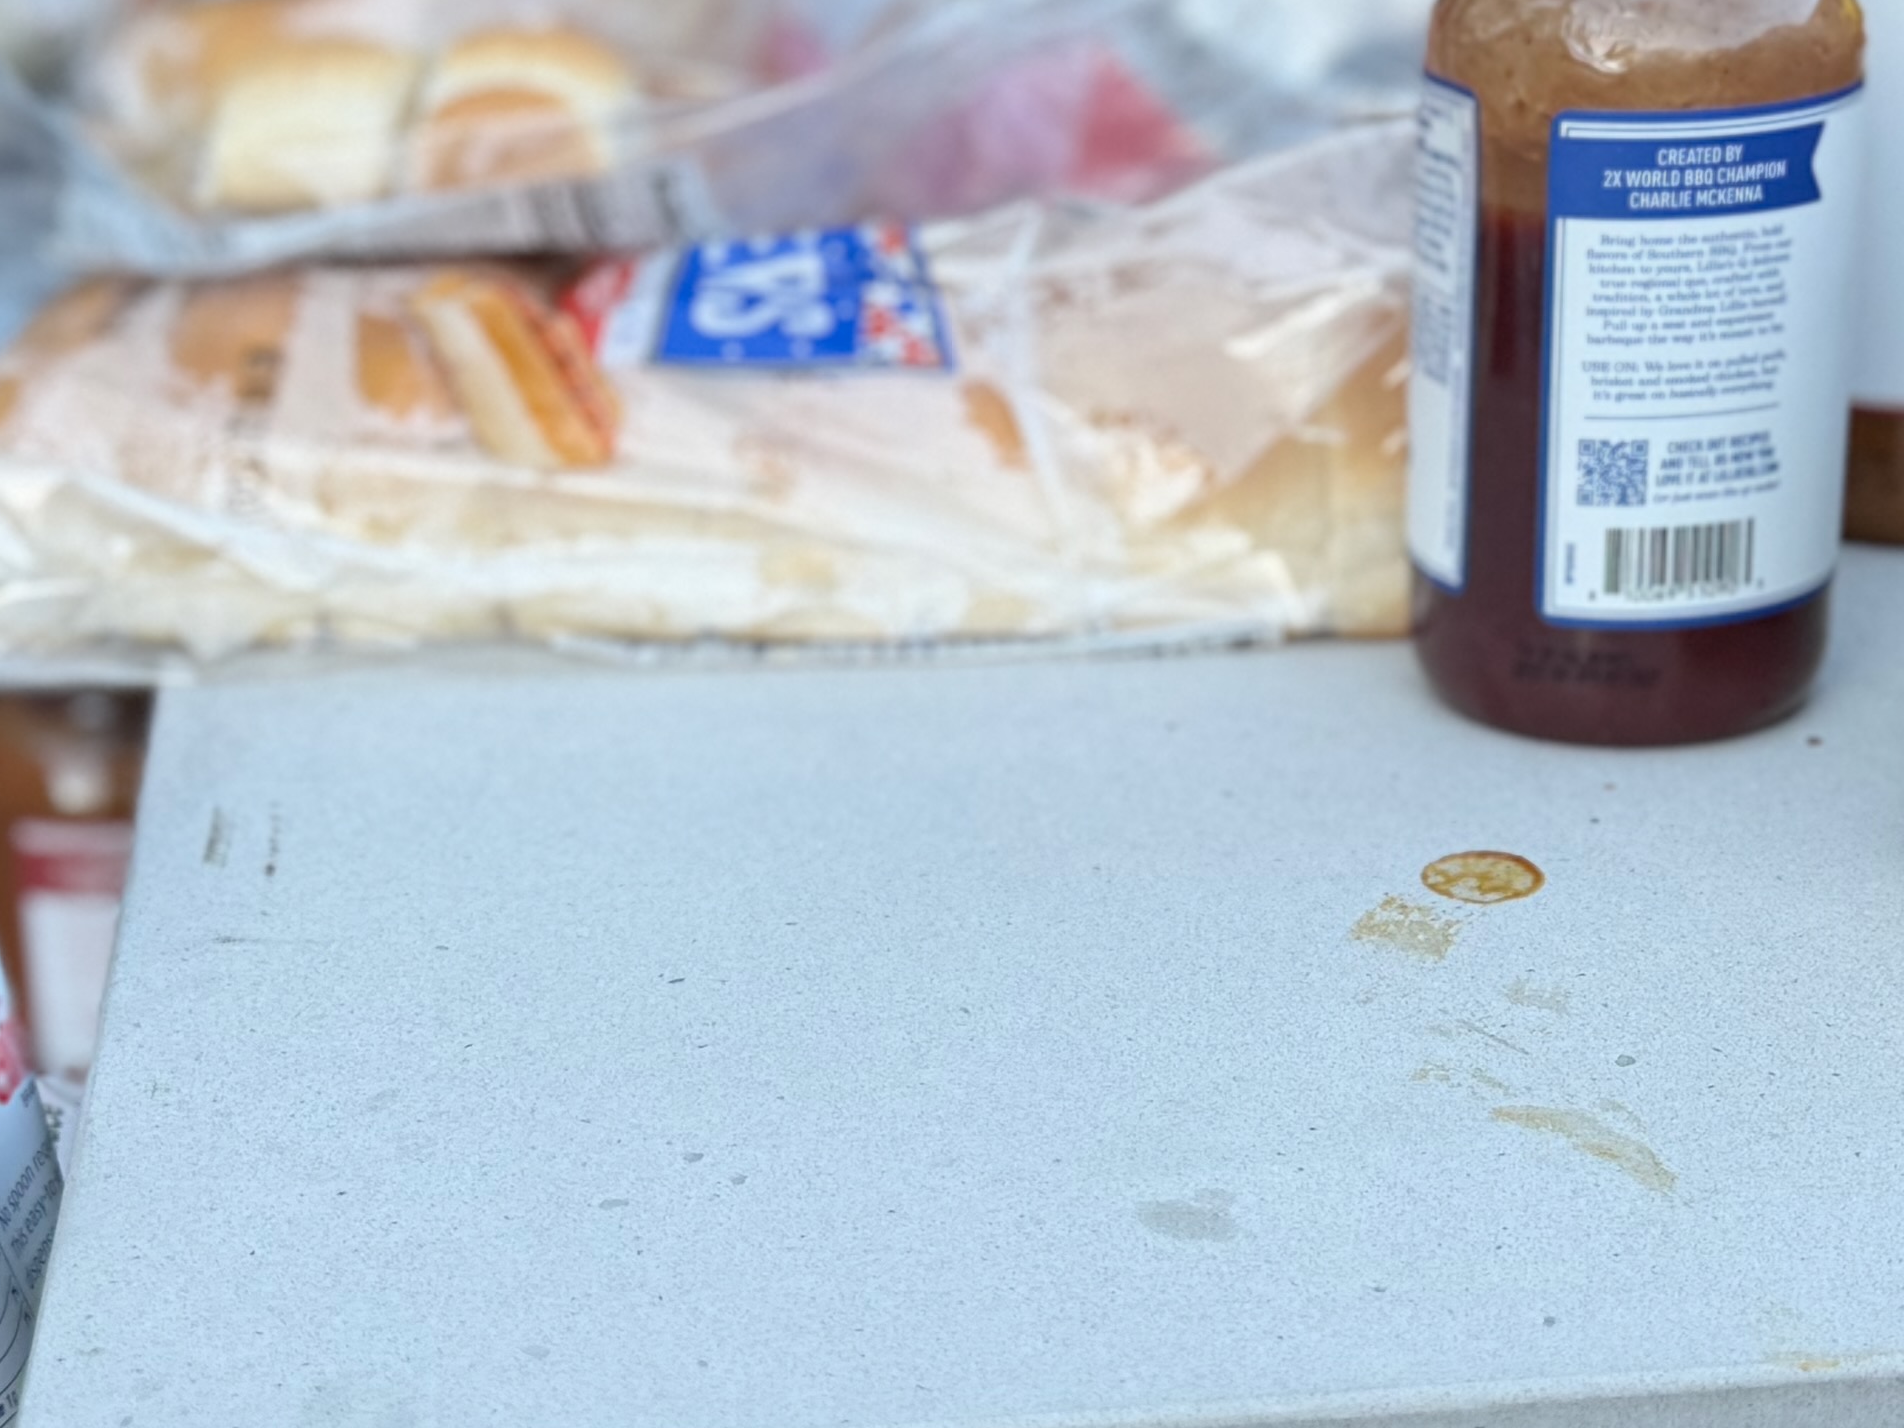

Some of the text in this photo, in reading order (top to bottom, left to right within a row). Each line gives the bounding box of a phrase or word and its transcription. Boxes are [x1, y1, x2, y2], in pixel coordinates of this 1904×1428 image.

[1658, 144, 1743, 166] CREATED BY
[1603, 161, 1786, 188] 2X WORLD BBQ CHAMPION
[1629, 185, 1763, 209] CHARLIE MCKENNA
